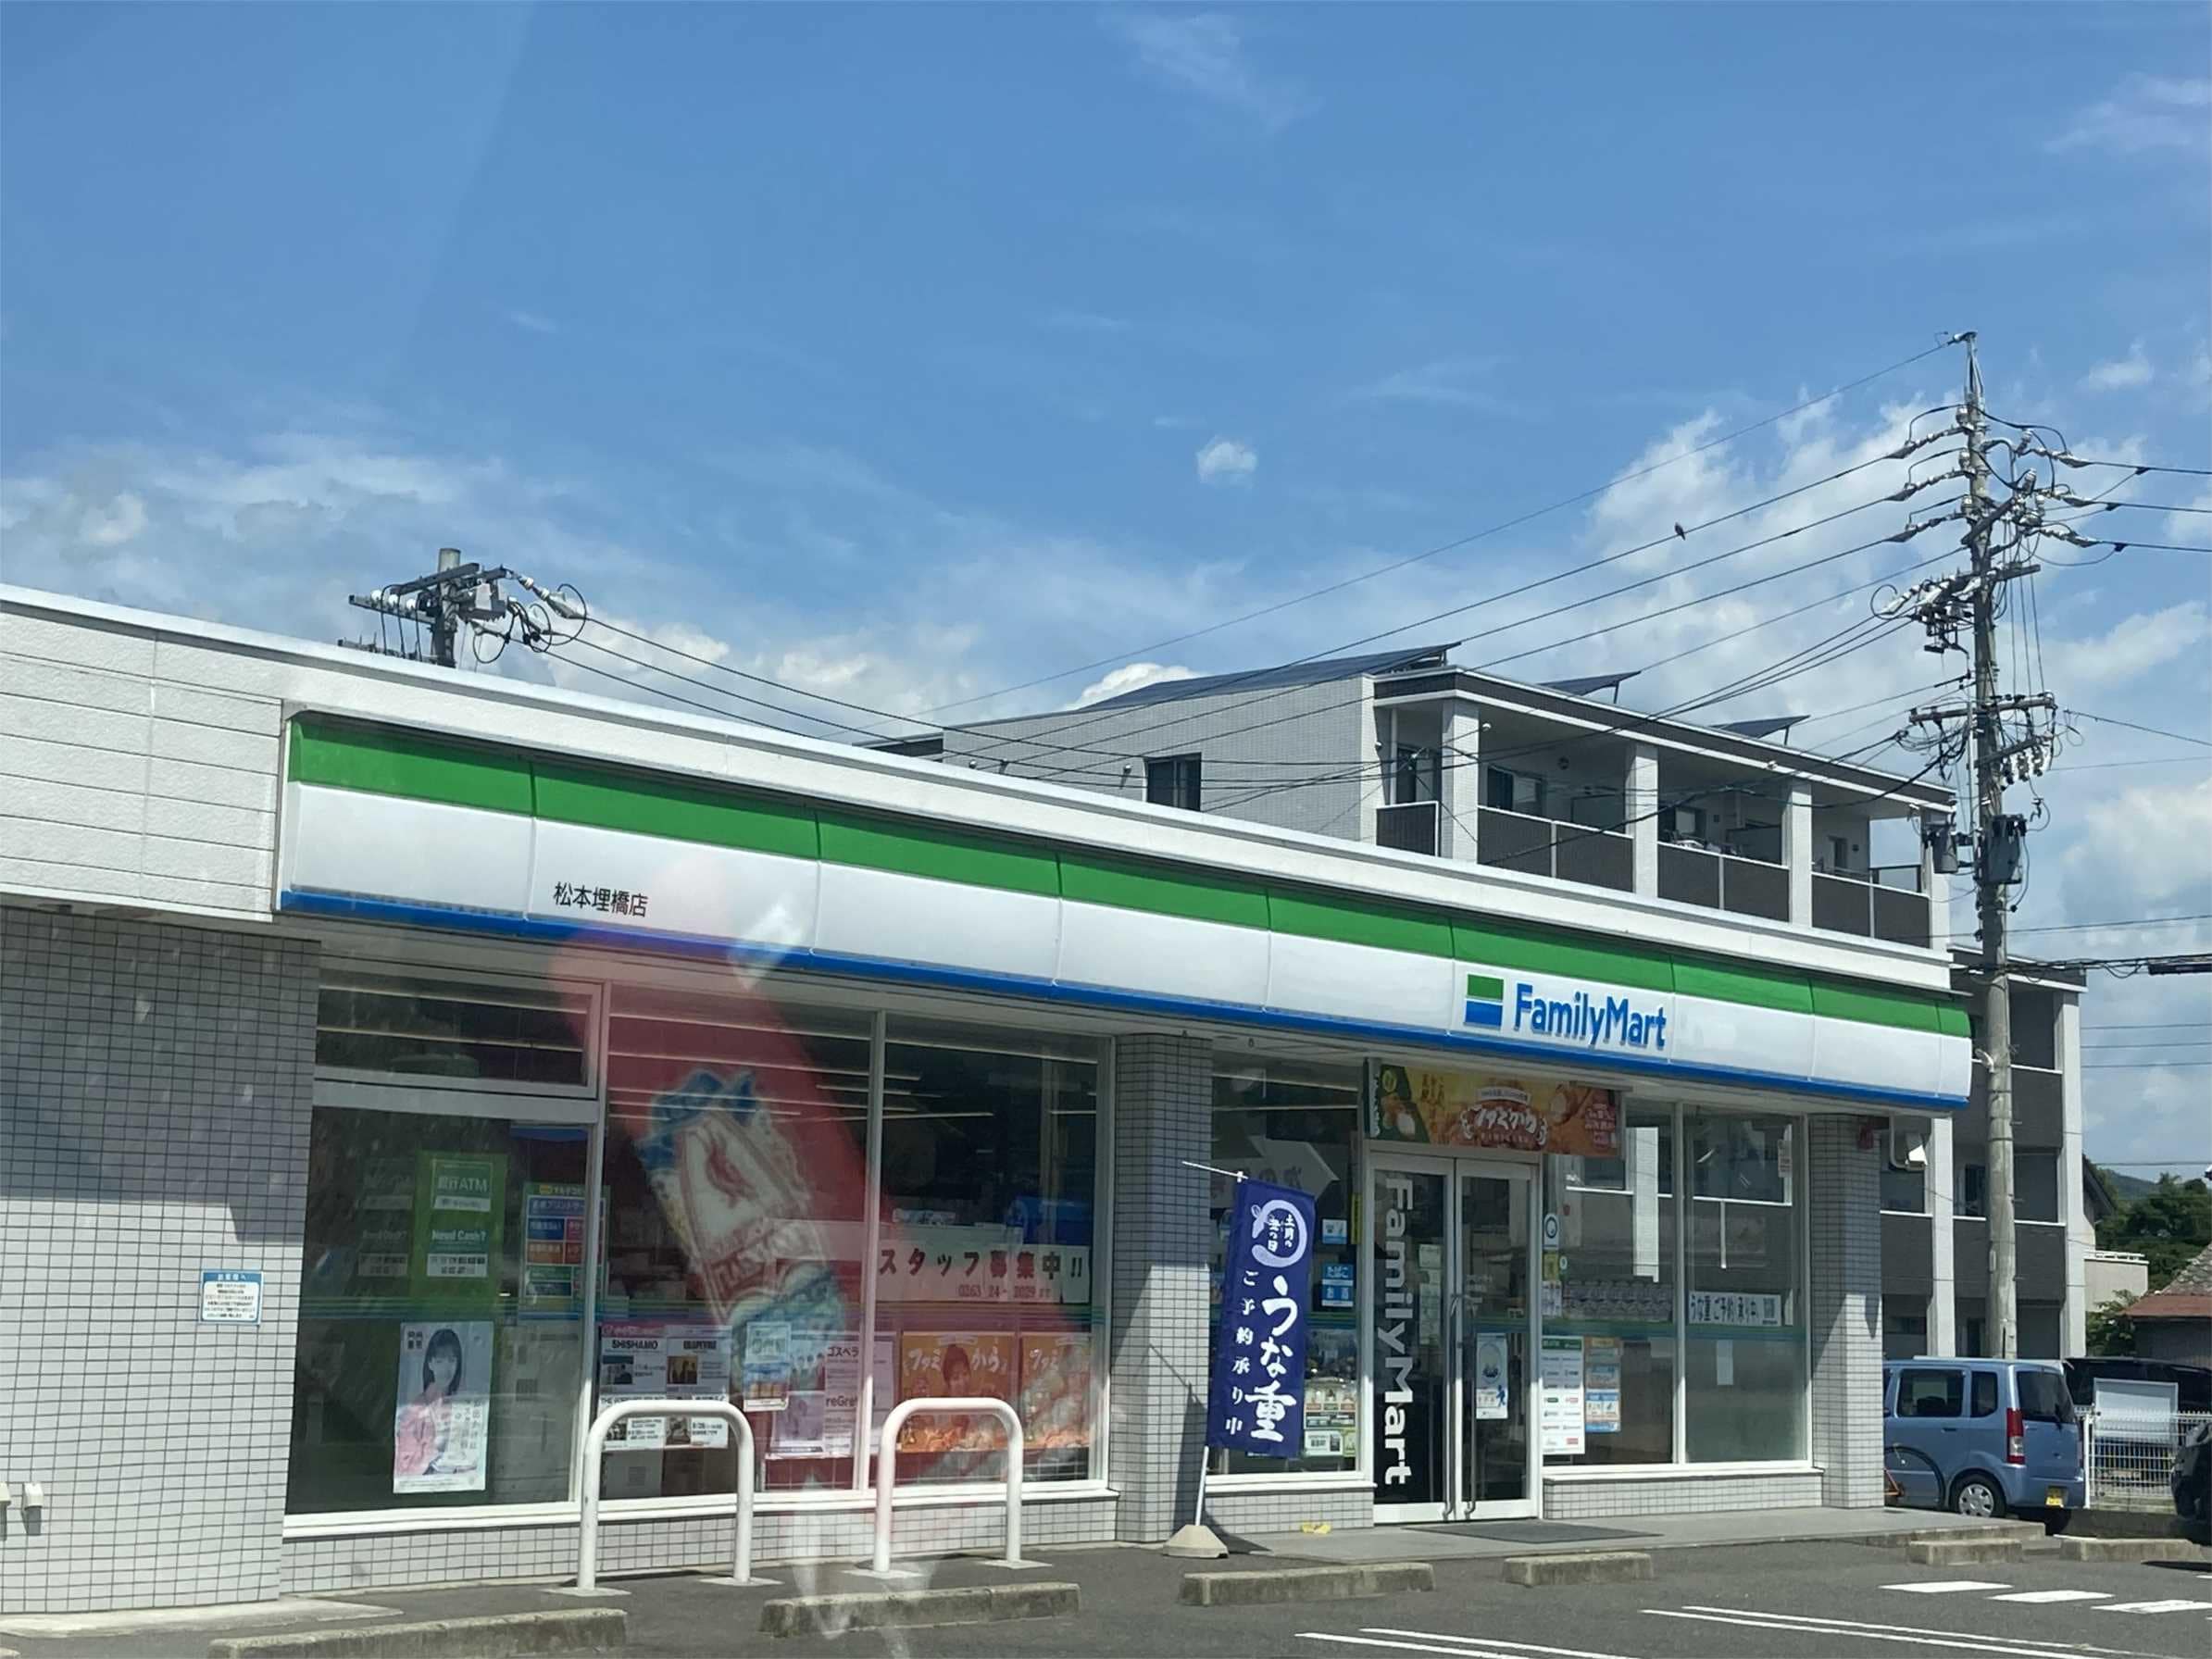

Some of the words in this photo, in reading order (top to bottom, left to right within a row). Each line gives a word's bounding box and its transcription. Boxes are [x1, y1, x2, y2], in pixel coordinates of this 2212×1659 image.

[554, 881, 648, 917] 松本埋橋店
[1514, 982, 1667, 1051] FamilyMart
[1225, 1270, 1258, 1435] ご予約承り中
[1244, 1274, 1296, 1442] うな重
[1377, 1178, 1414, 1485] FamilyMart
